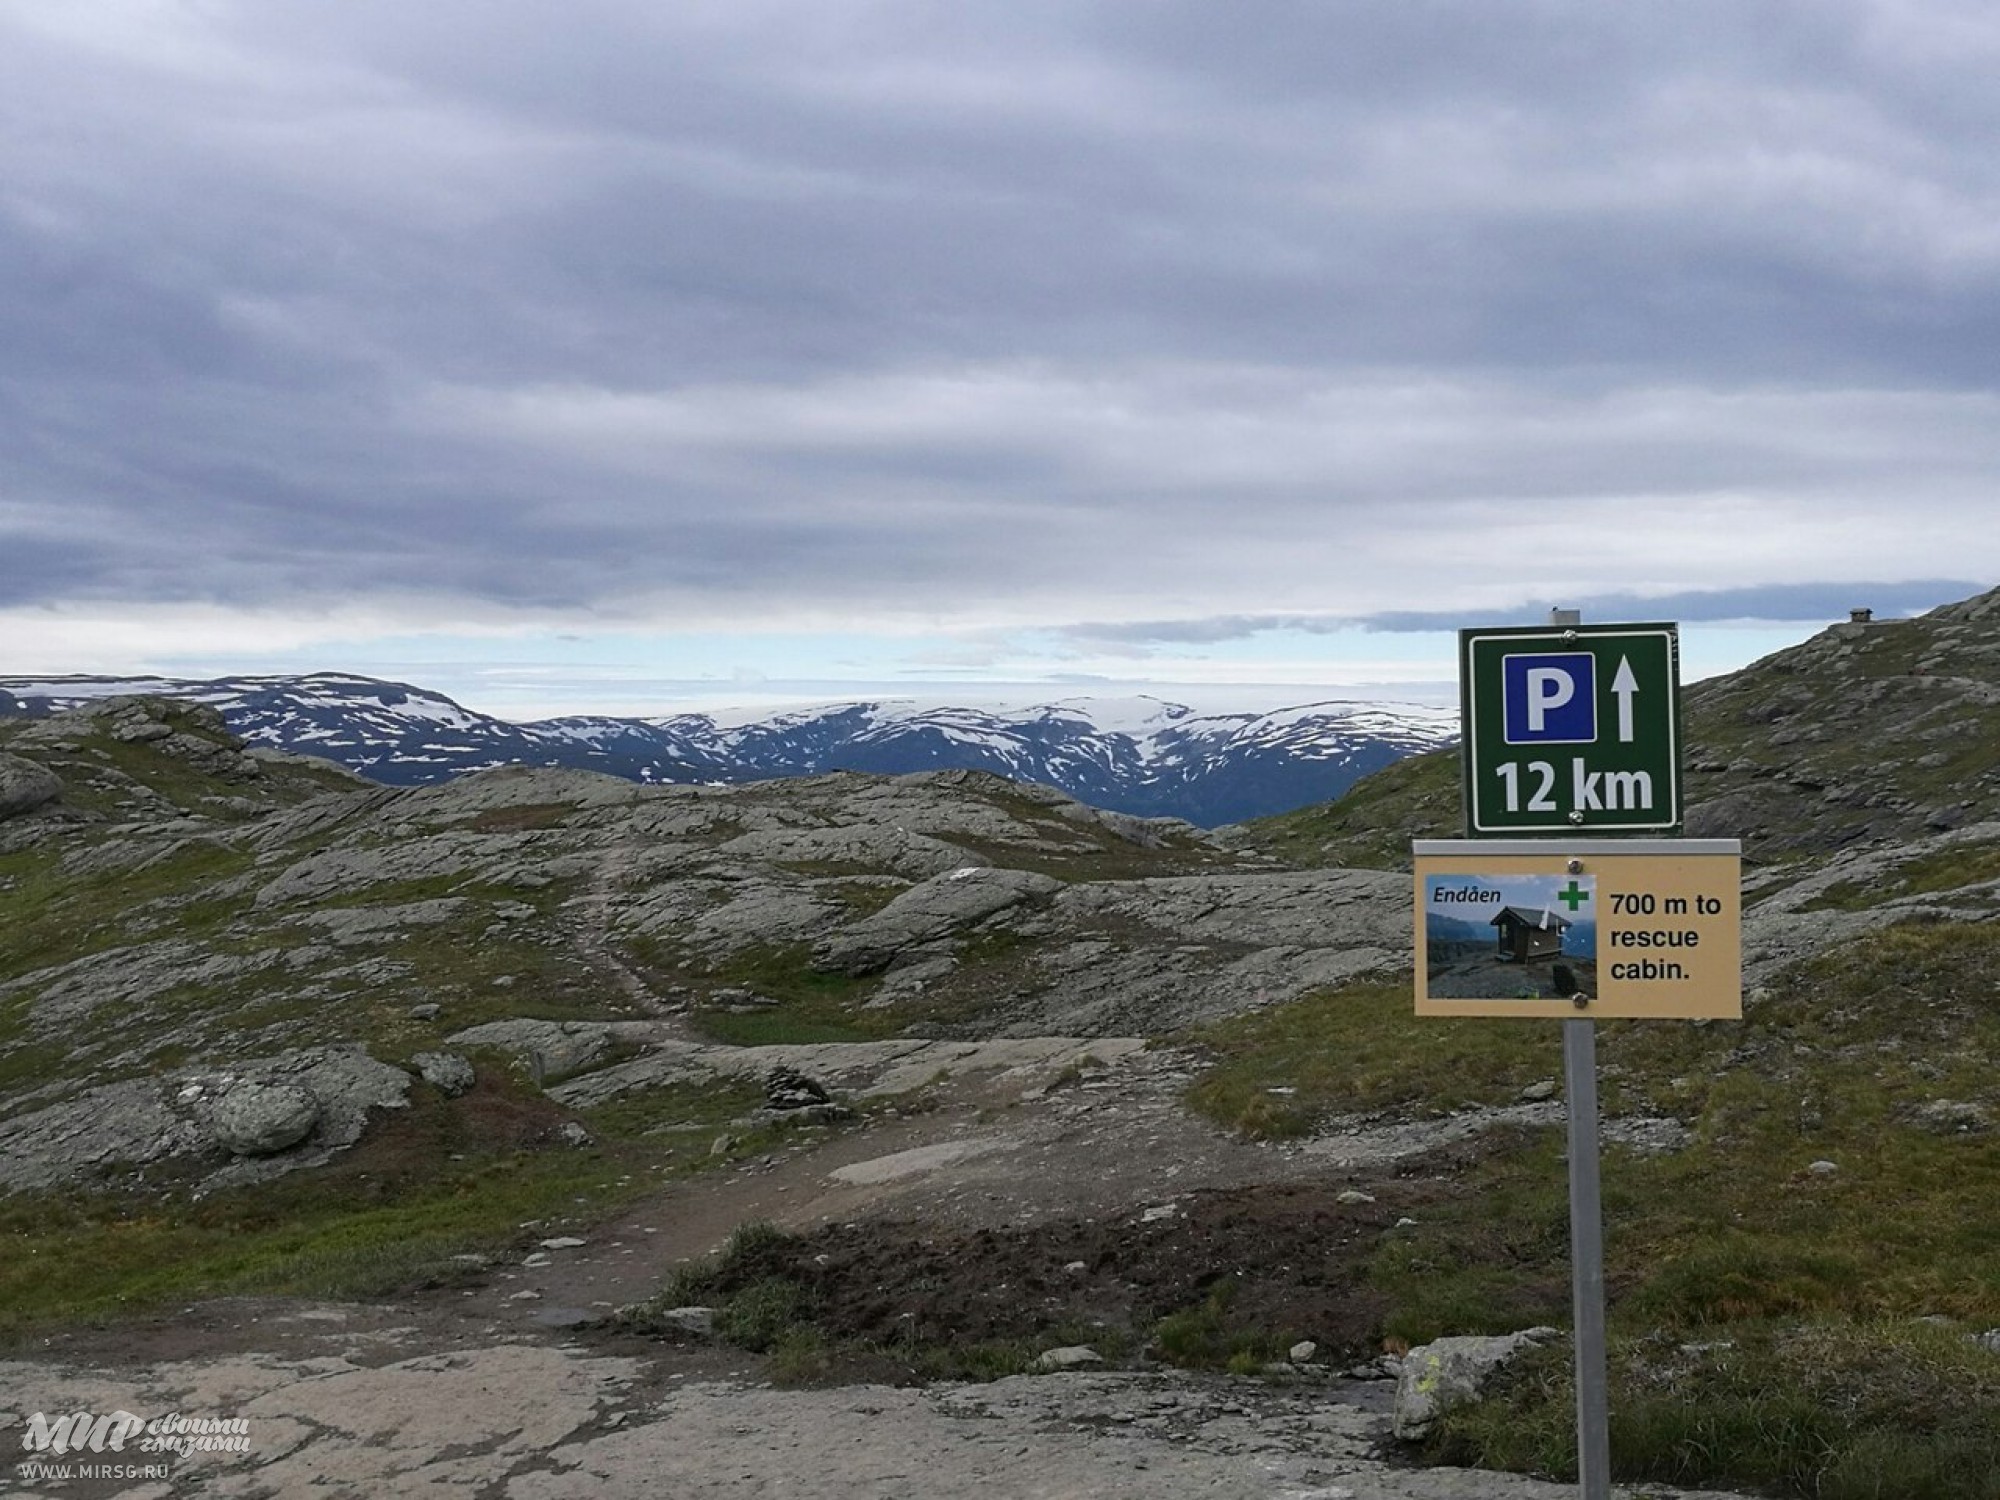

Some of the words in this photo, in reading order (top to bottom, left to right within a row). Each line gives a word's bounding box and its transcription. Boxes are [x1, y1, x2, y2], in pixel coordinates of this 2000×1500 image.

[1527, 667, 1575, 732] P
[1496, 760, 1557, 812] 12
[1572, 757, 1653, 811] km
[1433, 886, 1501, 904] Endåen
[1610, 894, 1656, 915] 700
[1664, 898, 1688, 915] m
[1697, 895, 1721, 915] to
[1610, 930, 1699, 948] rescue
[1610, 958, 1690, 980] cabin.
